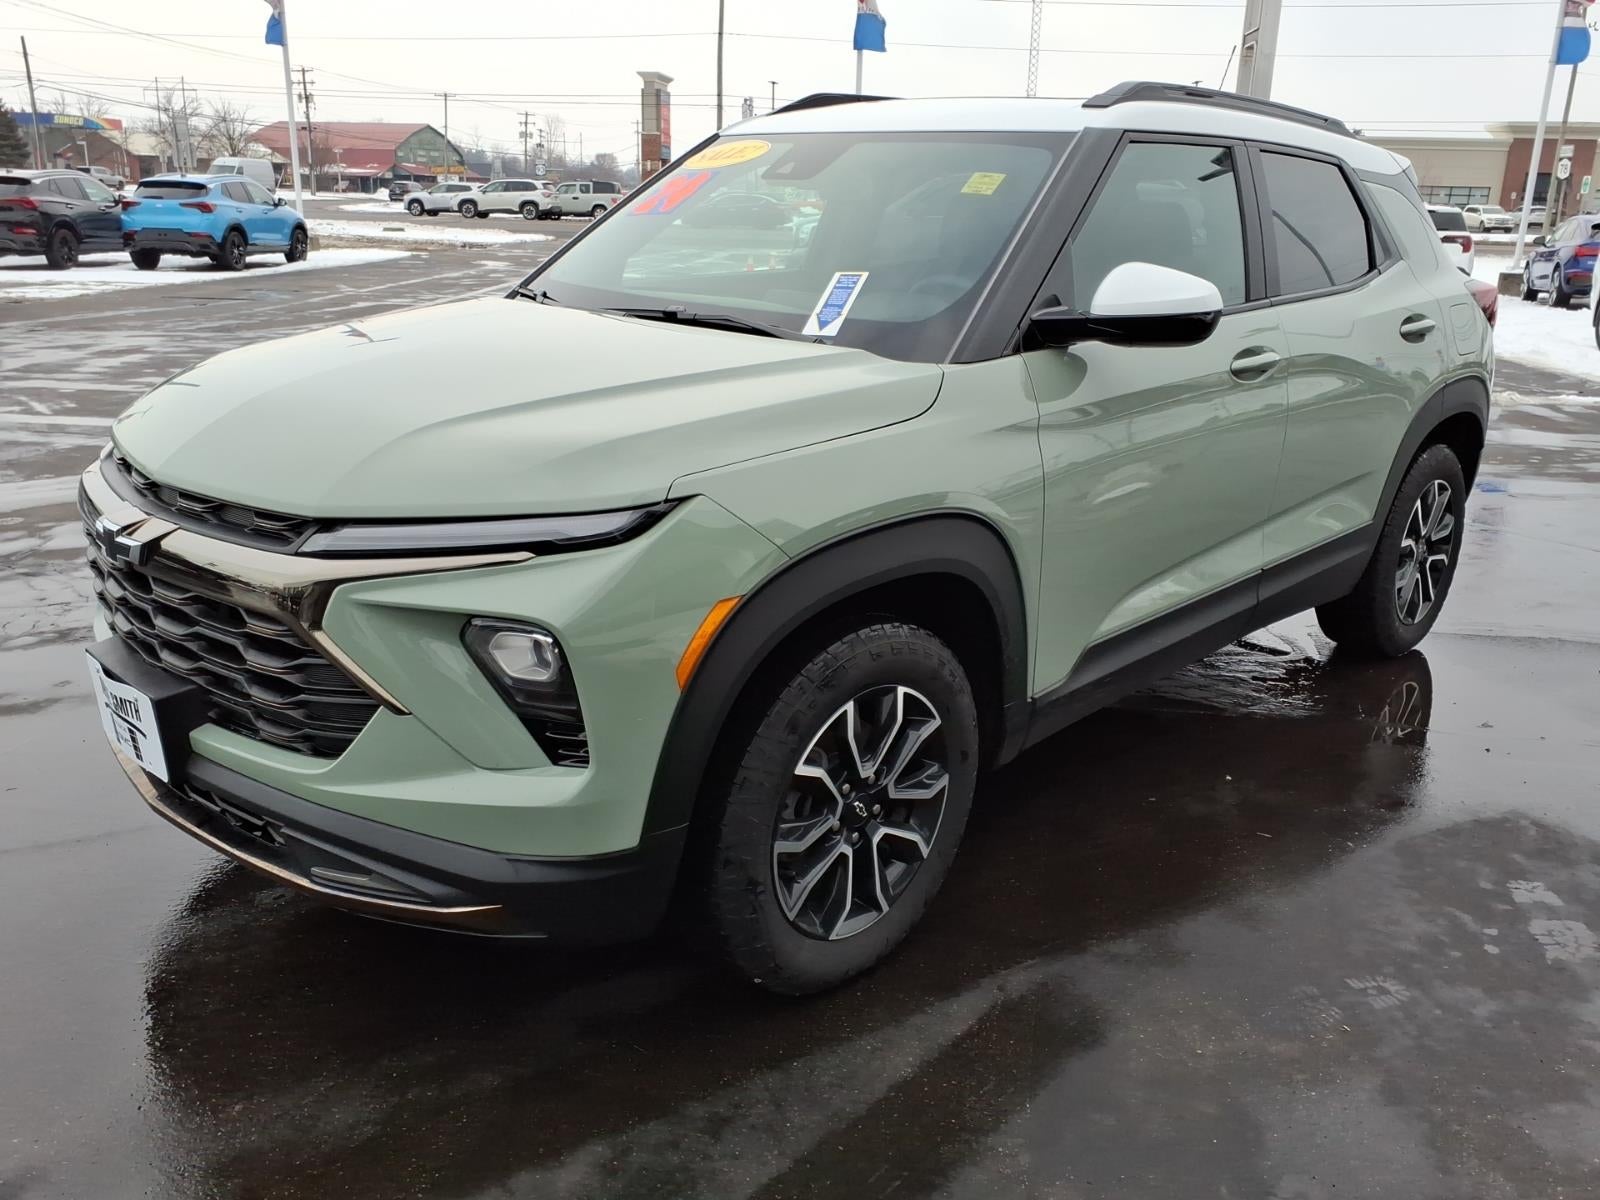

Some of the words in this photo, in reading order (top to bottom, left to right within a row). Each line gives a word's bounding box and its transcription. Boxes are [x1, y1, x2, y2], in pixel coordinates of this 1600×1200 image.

[54, 114, 84, 125] SUNOCO
[1560, 163, 1569, 174] 78
[110, 692, 142, 722] SMITH
